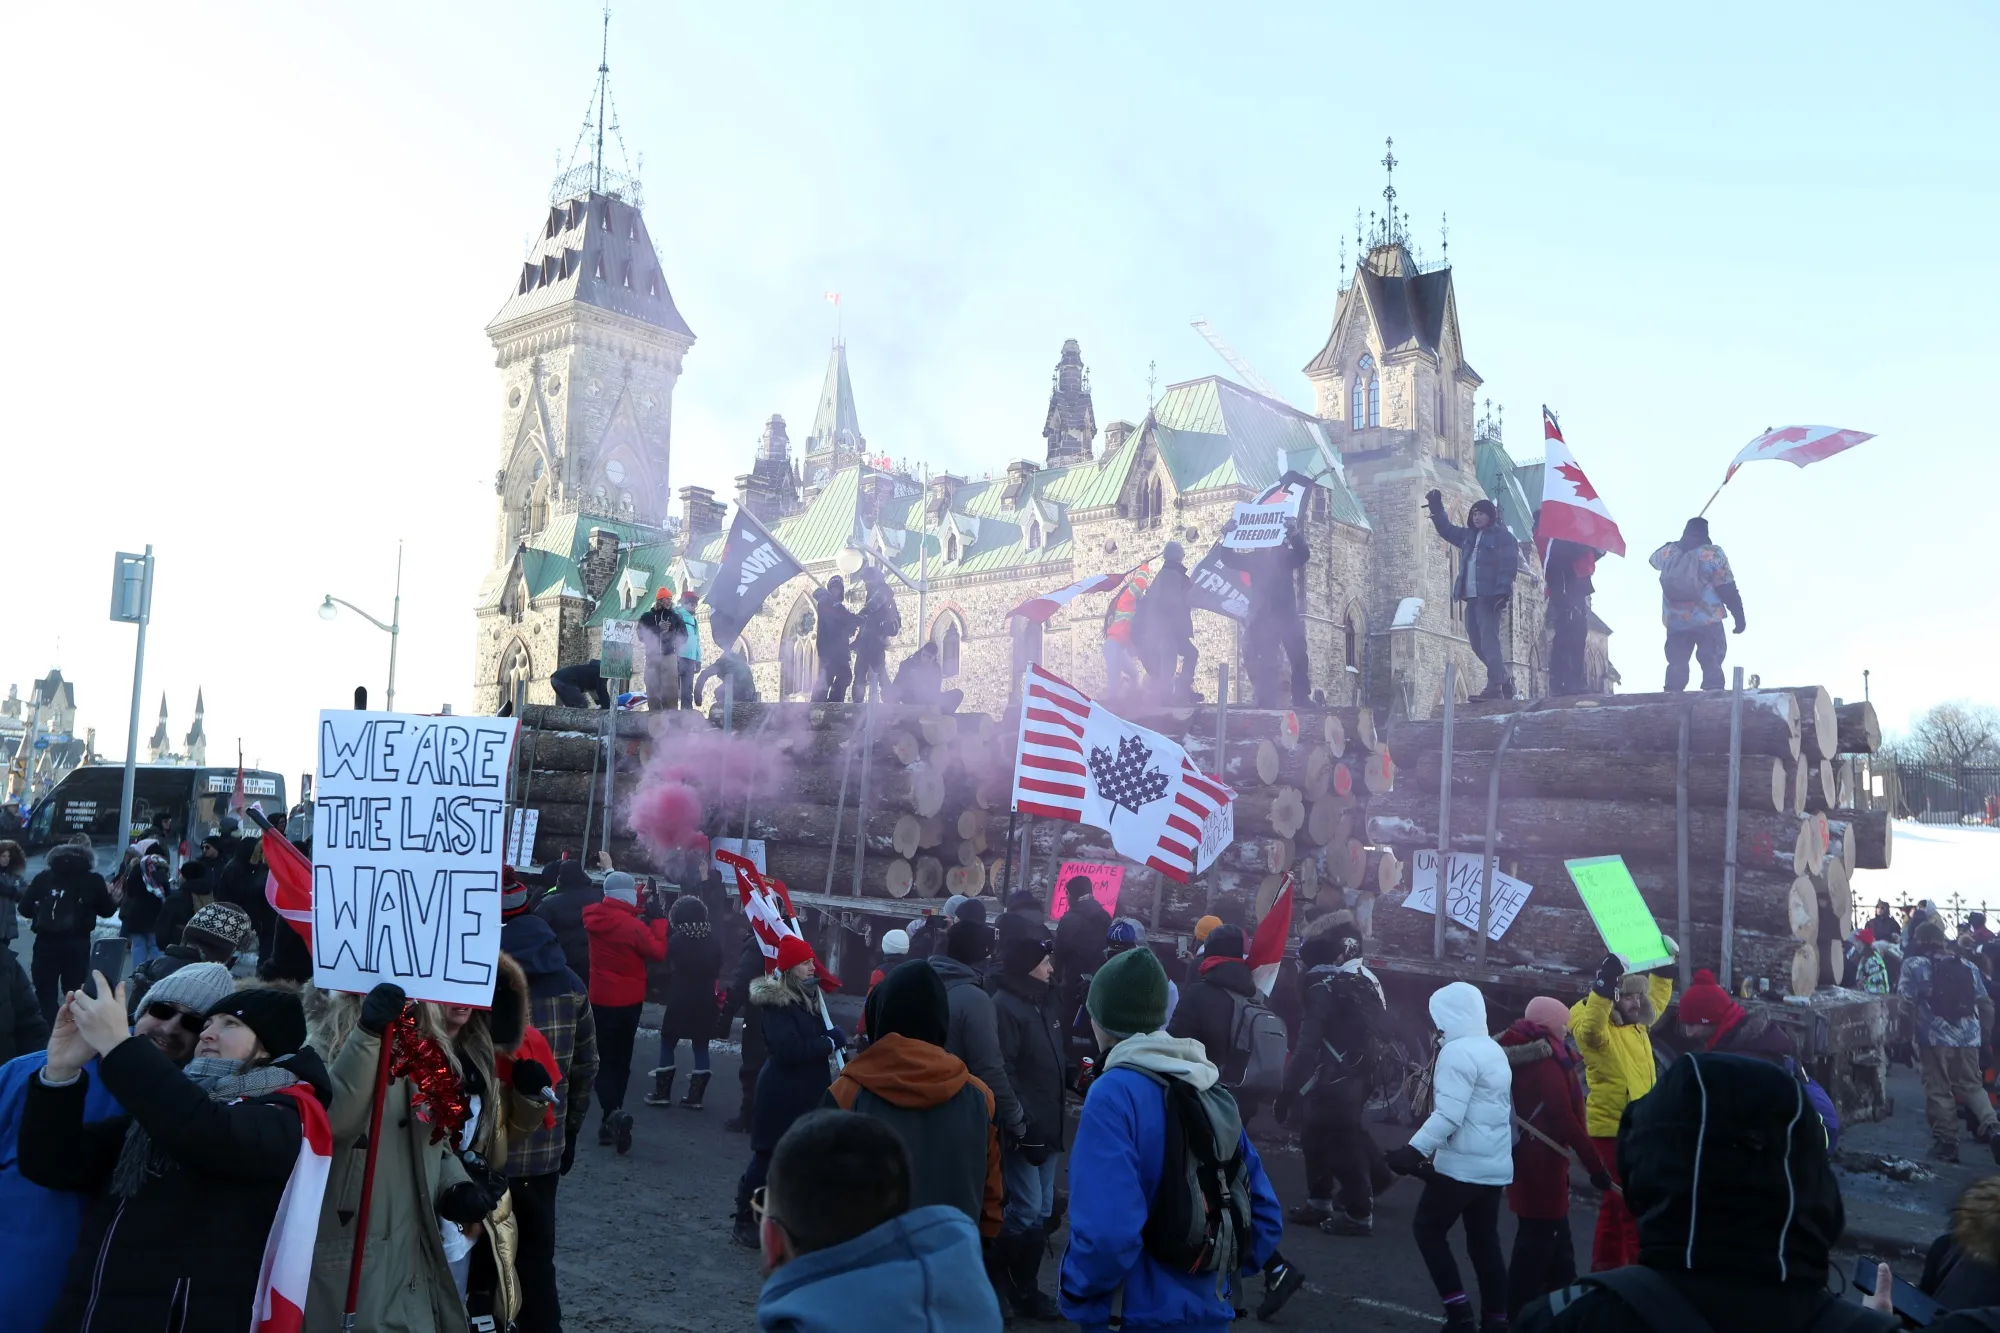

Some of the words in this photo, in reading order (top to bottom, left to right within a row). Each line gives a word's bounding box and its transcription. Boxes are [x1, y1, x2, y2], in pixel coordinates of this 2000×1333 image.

[1234, 529, 1279, 540] FREEDOM
[1239, 511, 1285, 525] MANDATE
[323, 720, 405, 782] WE
[407, 724, 507, 787] ARE
[210, 784, 235, 792] FREEDO
[244, 786, 274, 795] SUPPORT
[318, 797, 391, 851] THE
[401, 796, 503, 855] LAST
[1065, 864, 1118, 877] MANDATE
[1449, 856, 1484, 896] WE
[1490, 878, 1527, 915] THE
[314, 865, 498, 985] WAVE
